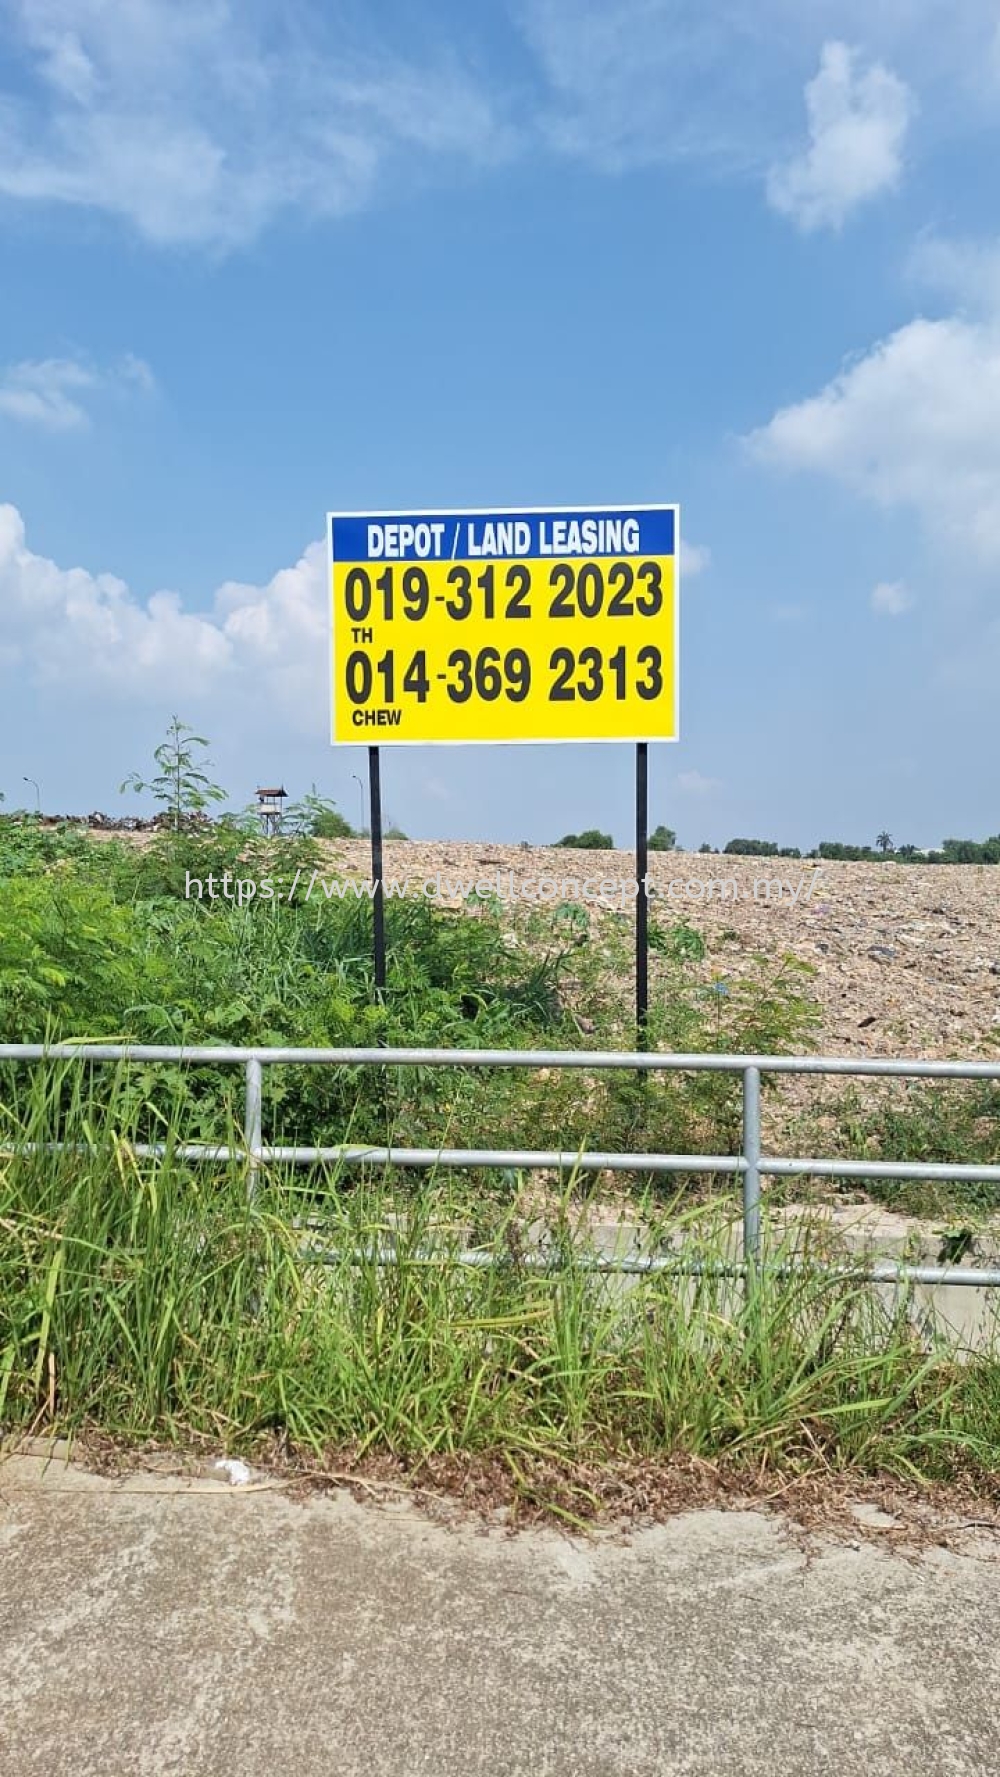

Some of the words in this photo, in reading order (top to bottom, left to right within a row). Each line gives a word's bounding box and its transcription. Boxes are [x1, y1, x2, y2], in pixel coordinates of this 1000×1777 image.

[368, 523, 445, 558] DEPOT
[452, 522, 460, 560] /
[467, 521, 531, 556] LAND
[539, 518, 640, 555] LEASING
[345, 565, 531, 622] 019-312
[548, 562, 663, 618] 2023
[351, 628, 373, 644] TH
[345, 647, 531, 704] 014-369
[548, 645, 663, 701] 2313
[352, 709, 402, 726] CHEW
